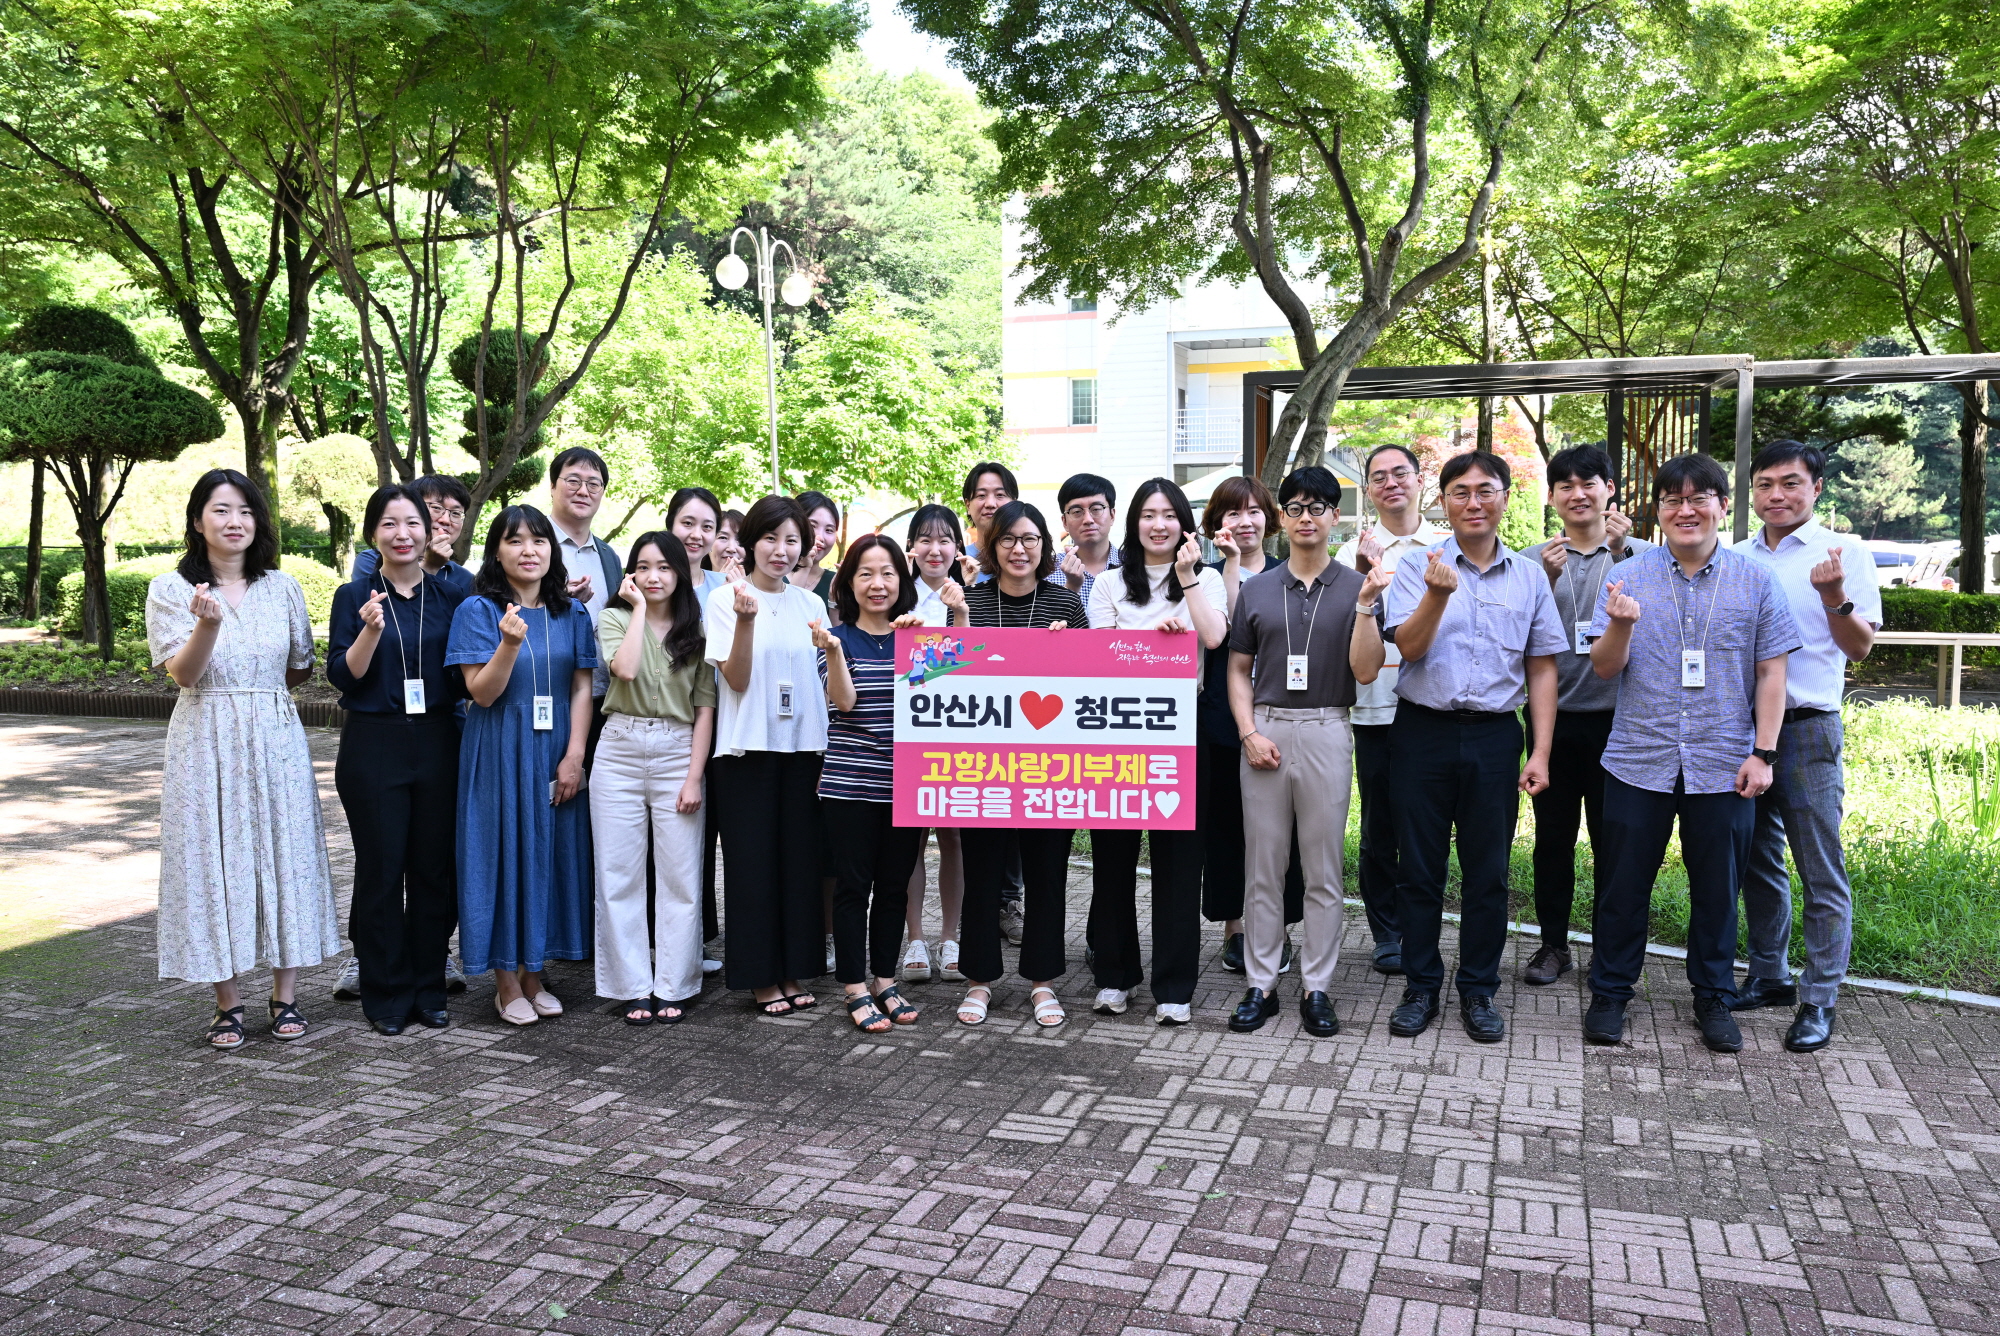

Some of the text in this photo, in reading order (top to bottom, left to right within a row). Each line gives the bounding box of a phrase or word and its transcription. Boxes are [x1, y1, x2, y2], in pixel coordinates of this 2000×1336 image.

[1109, 640, 1133, 654] 시민과
[1116, 653, 1192, 666] 자유로운 혁신도시 안산
[909, 693, 1178, 731] 안산시 청도군
[921, 750, 1179, 785] 고향사랑기부제로
[917, 786, 1153, 820] 마음을 전합니다
